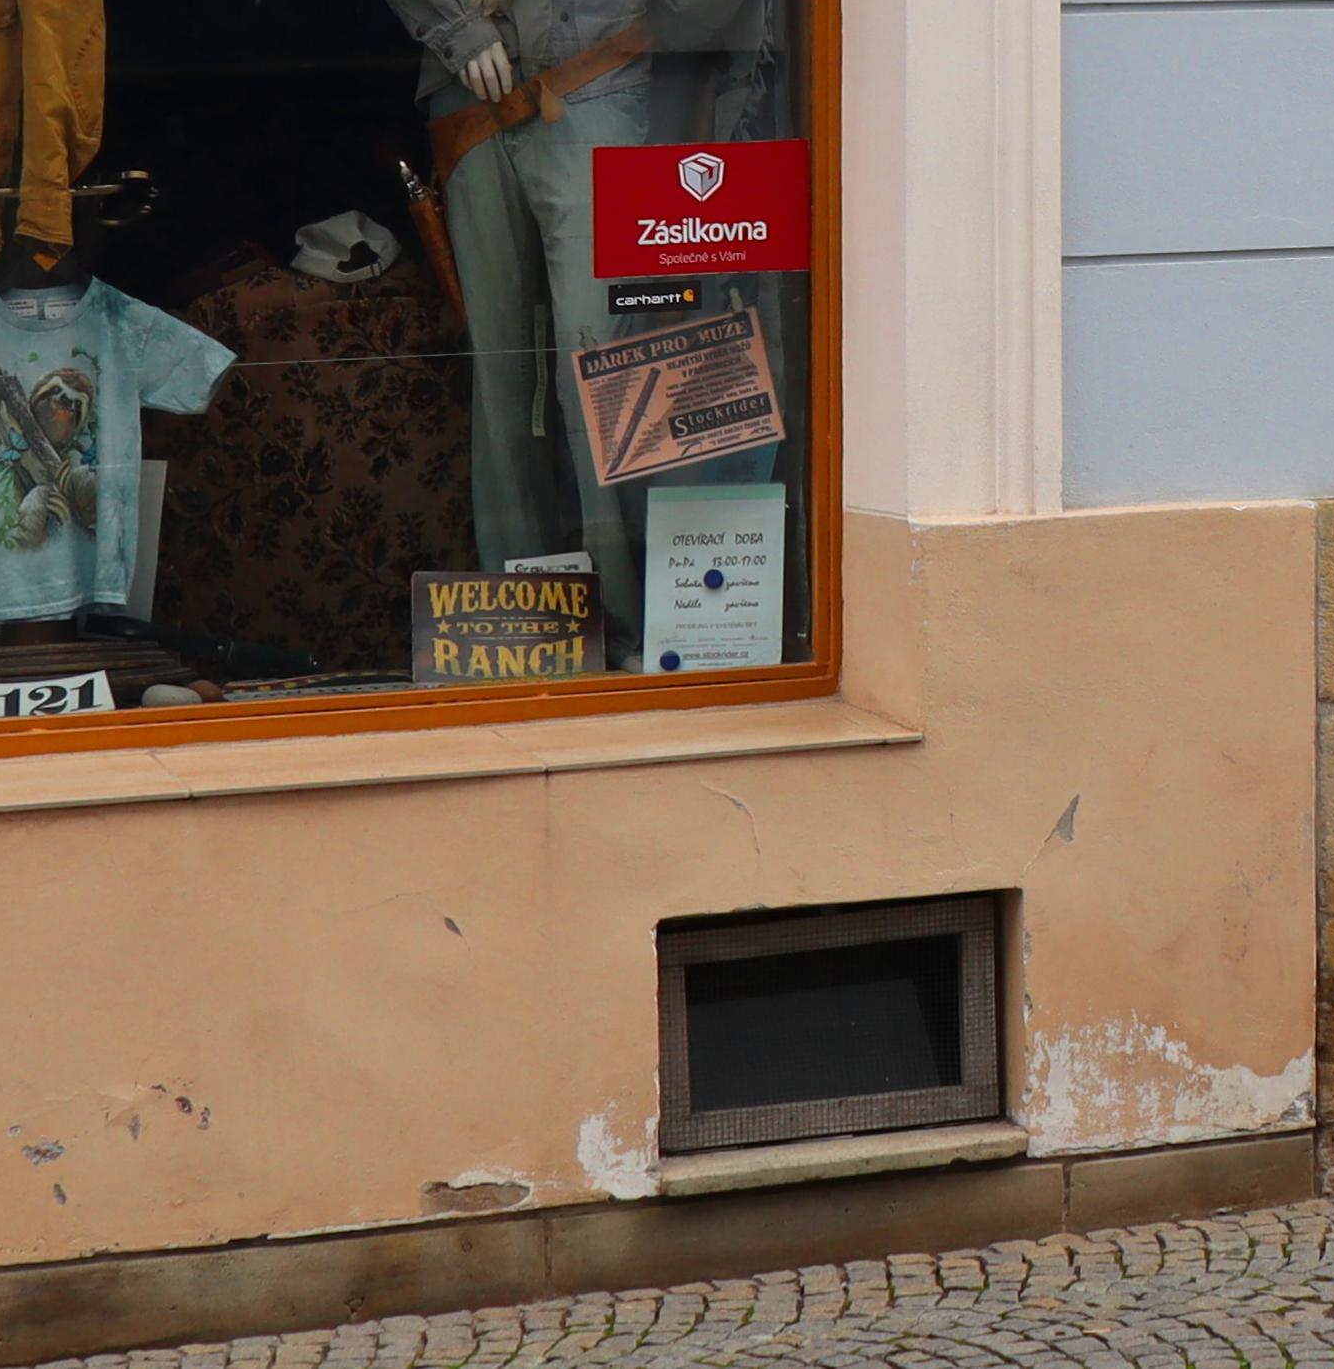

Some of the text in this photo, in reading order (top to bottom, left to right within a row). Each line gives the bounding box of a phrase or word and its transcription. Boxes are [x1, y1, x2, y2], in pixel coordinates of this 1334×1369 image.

[636, 217, 768, 246] Zásilkovna
[658, 250, 747, 266] Společně s Vámi
[615, 291, 683, 307] carhartt
[586, 319, 748, 375] DÁREK PRO MUŽE
[673, 397, 768, 437] Stockrider
[672, 531, 764, 547] OTEVÍRACÍ DOBA
[428, 580, 589, 619] WELCOME
[455, 620, 560, 635] TO THE
[432, 635, 586, 679] RANCH
